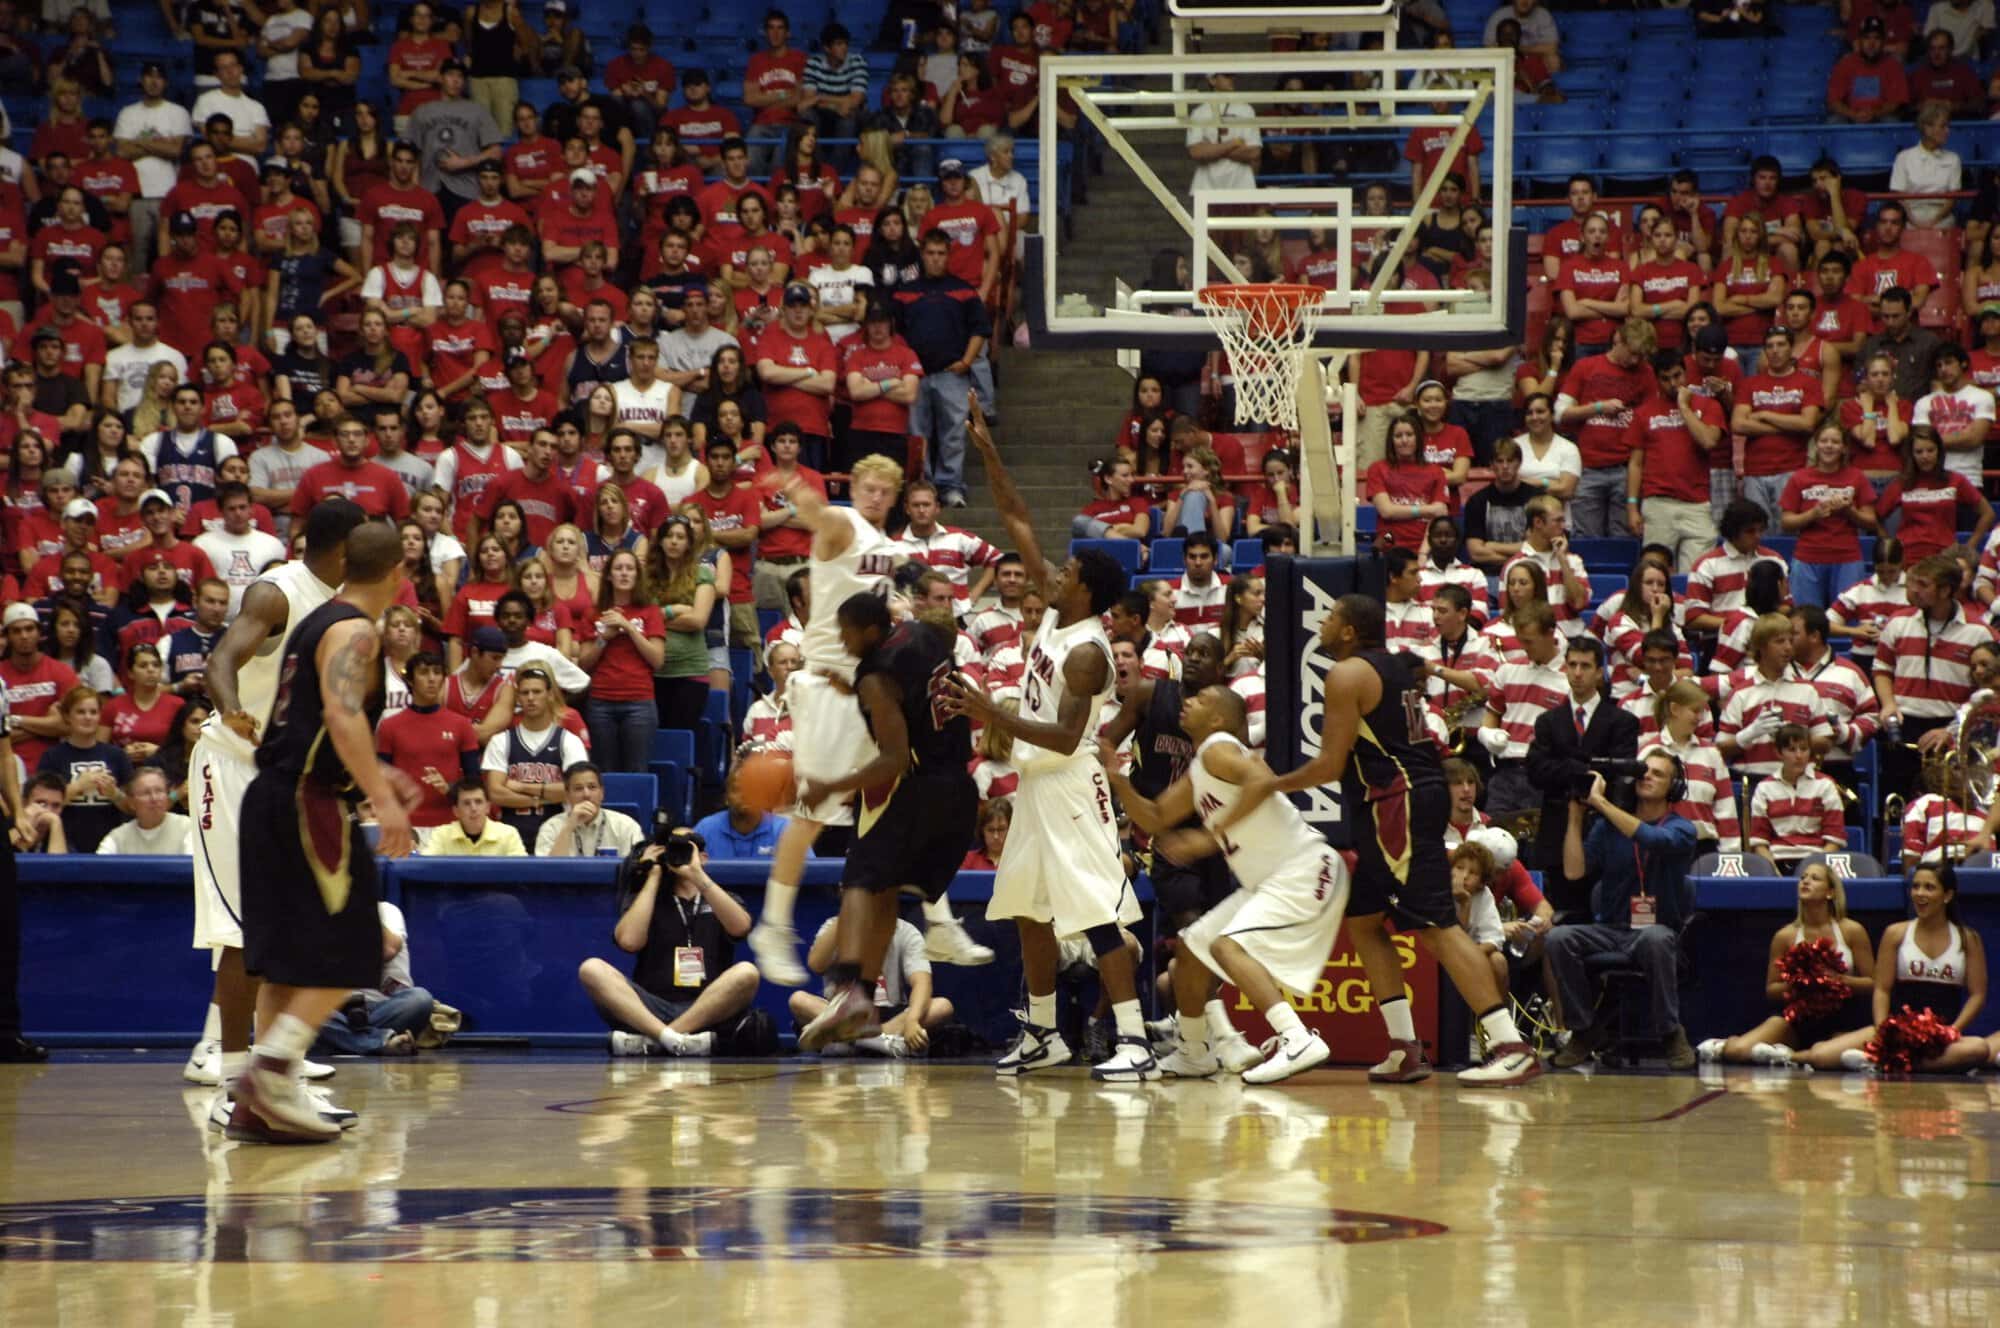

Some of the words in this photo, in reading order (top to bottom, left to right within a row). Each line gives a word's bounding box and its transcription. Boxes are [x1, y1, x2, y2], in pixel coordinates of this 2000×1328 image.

[619, 405, 666, 423] ARIZONA
[202, 763, 215, 831] CATS
[1092, 773, 1110, 824] CATS
[1711, 854, 1750, 878] A
